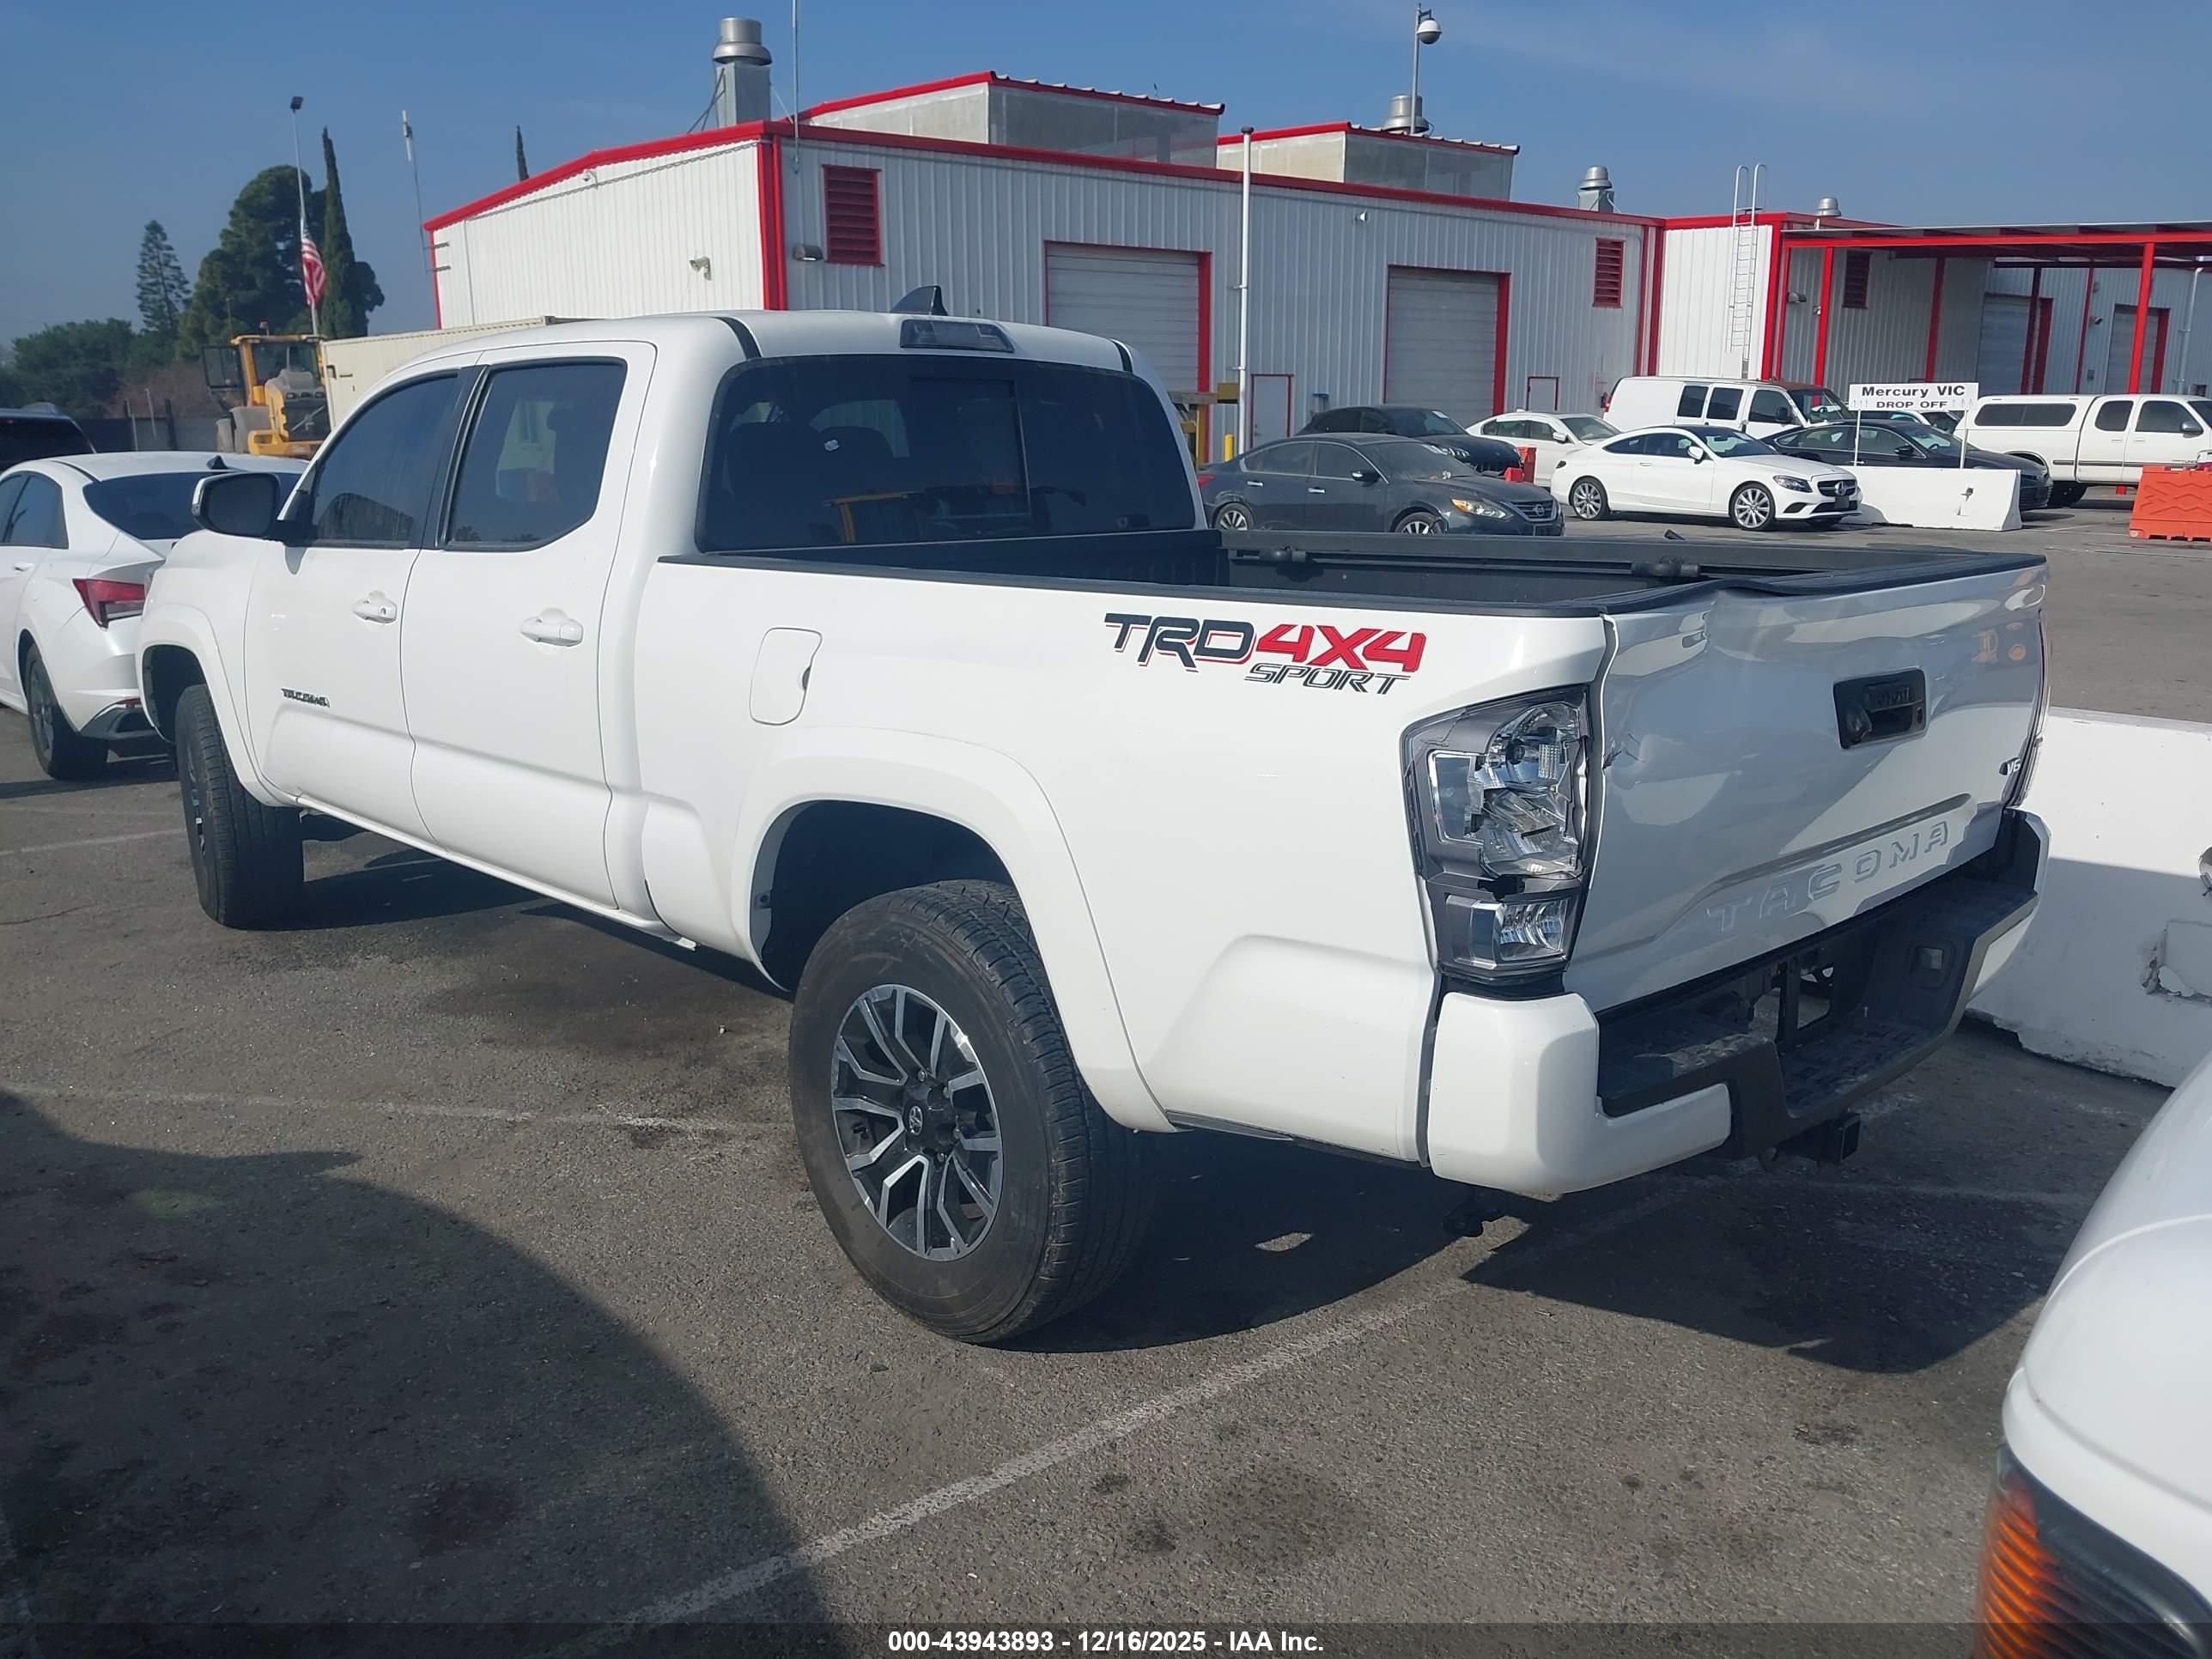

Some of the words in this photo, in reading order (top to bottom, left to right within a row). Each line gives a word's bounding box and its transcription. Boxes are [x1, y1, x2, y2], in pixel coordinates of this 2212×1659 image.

[1862, 386, 1929, 398] Mercury
[1937, 385, 1966, 396] VIC
[1920, 400, 1948, 409] OFF
[1243, 662, 1412, 695] SPORT
[2006, 758, 2022, 775] V6
[1704, 820, 1949, 933] TACOMA
